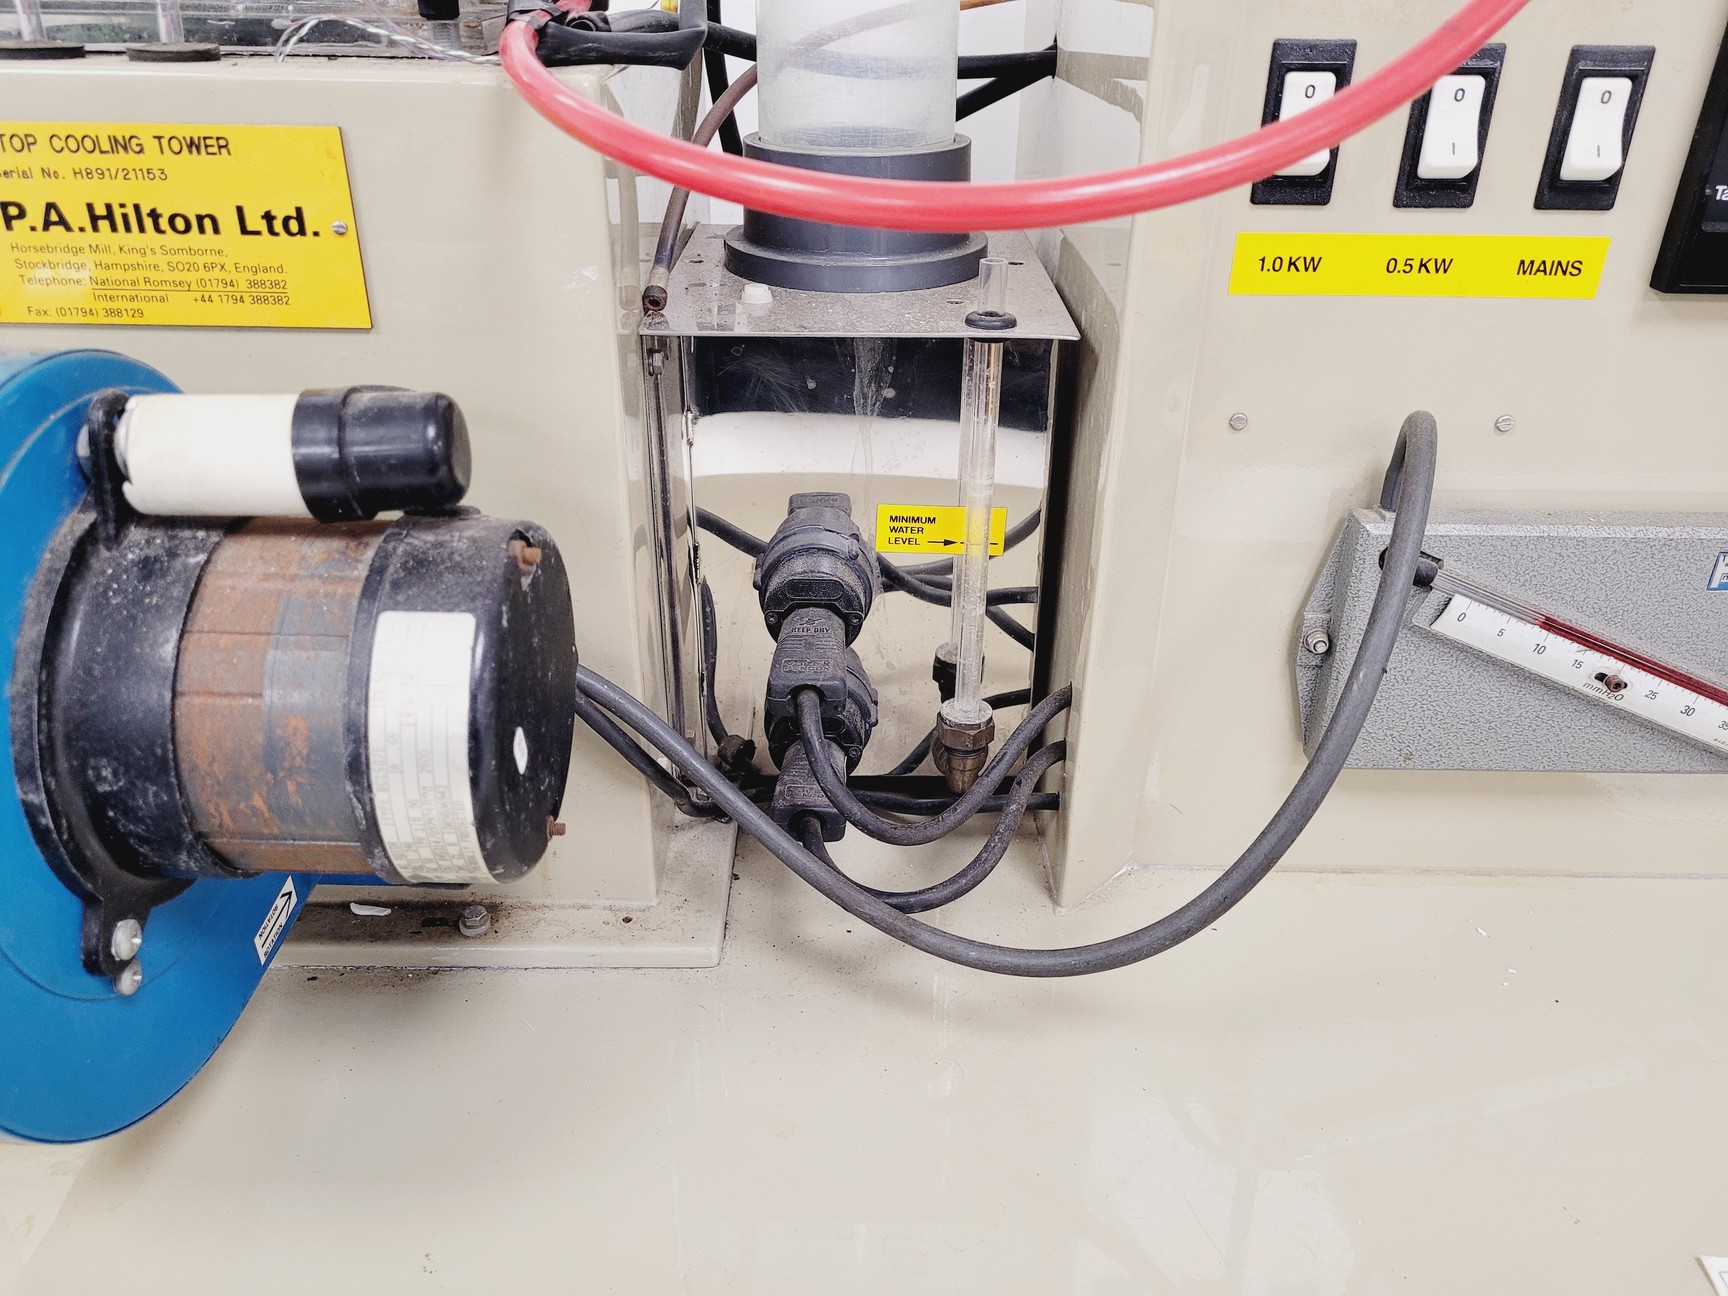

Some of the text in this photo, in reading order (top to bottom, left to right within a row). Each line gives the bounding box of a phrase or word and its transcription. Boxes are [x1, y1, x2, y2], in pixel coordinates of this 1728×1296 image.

[0, 133, 232, 156] TOP COOLING TOWER
[0, 166, 168, 181] erial No. H891/21153
[0, 201, 320, 237] P.A.Hilton Ltd.
[10, 242, 228, 258] Horsebridge Mill, King's Somborne,
[14, 258, 288, 276] Stockbridge, Hampshire, SO20 6PX, England.
[1257, 256, 1323, 273] 1.0 KW
[1385, 258, 1454, 275] 0.5 KW
[1516, 260, 1583, 276] MAINS
[18, 274, 288, 291] Telephone: National Romsey (01794) 388382
[93, 292, 291, 306] International +44 1794 388382
[27, 306, 144, 319] Fax: (01794) 388129
[889, 515, 936, 525] MINIMUM
[889, 526, 924, 535] WATER
[888, 537, 920, 546] LEVEL
[1457, 612, 1467, 622] 0
[1497, 628, 1506, 637] 5
[1532, 643, 1547, 655] 10
[1572, 659, 1584, 670] 15
[1644, 689, 1659, 701] 25
[1680, 704, 1696, 717] 30
[258, 904, 279, 940] ROTATION
[263, 922, 283, 958] ROTATION
